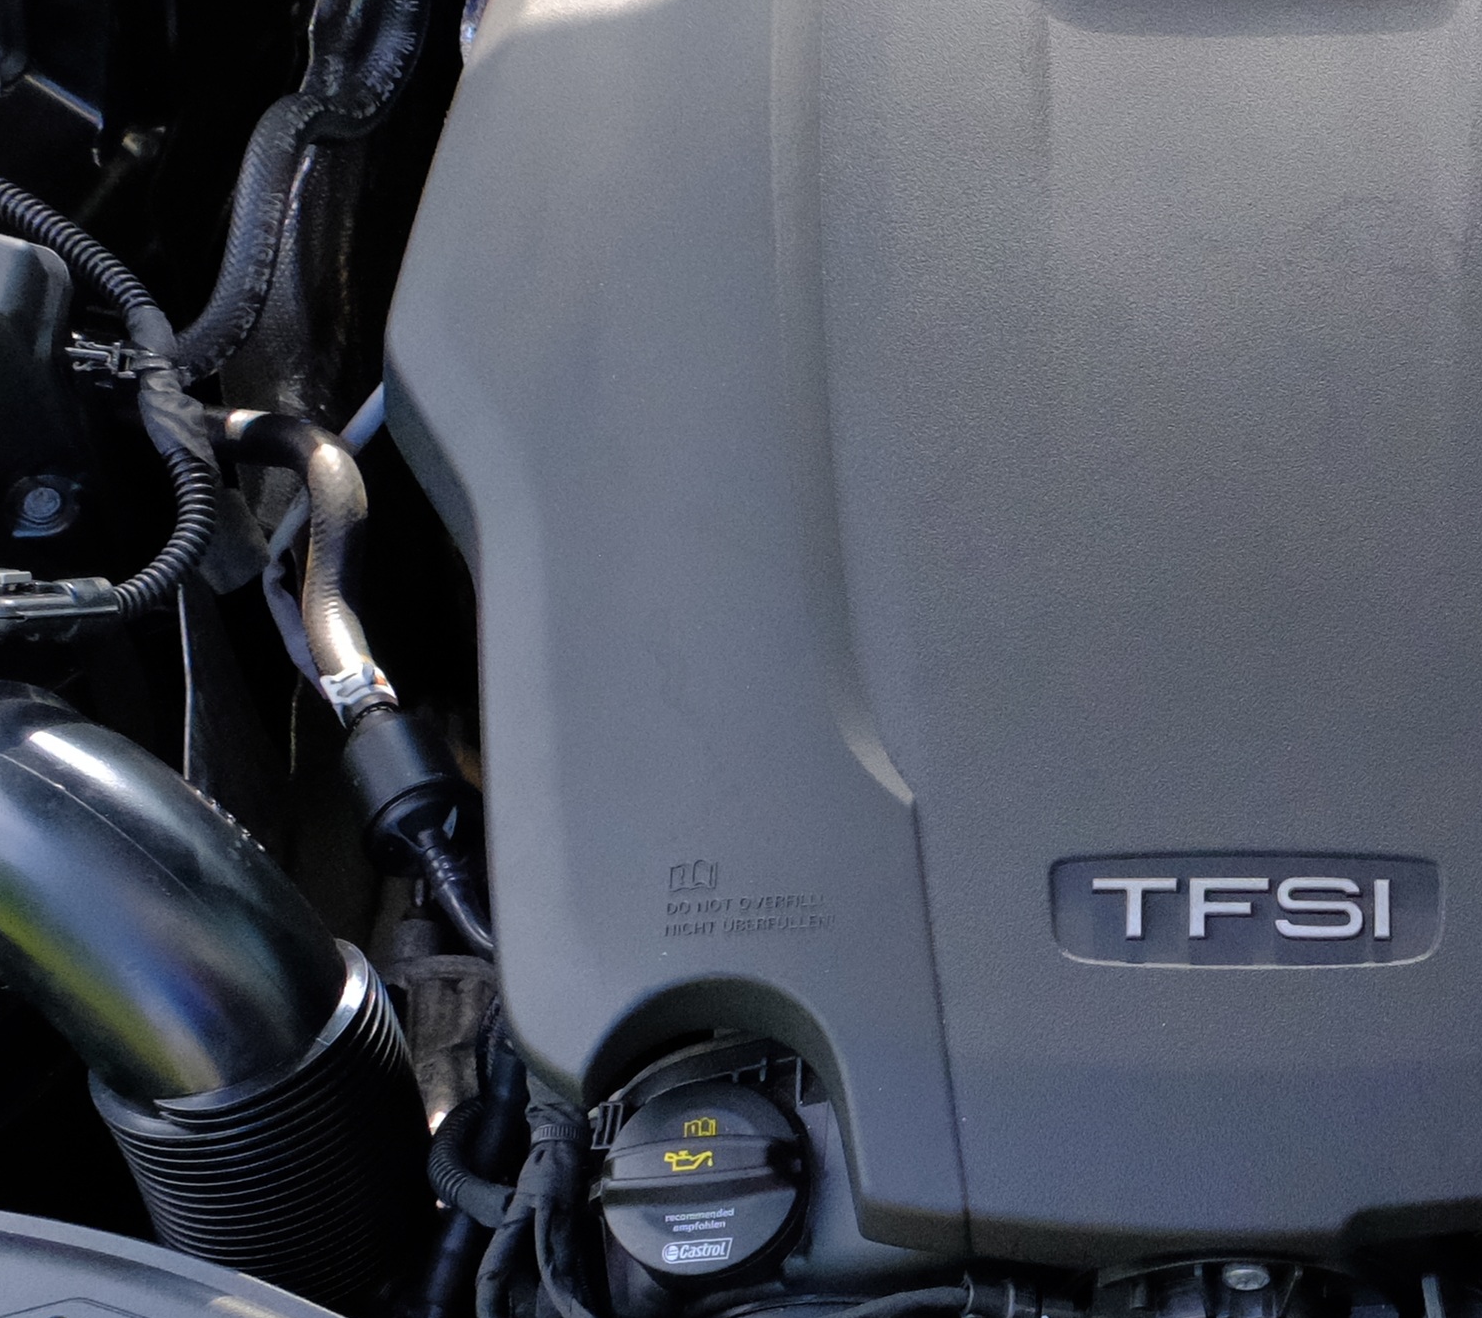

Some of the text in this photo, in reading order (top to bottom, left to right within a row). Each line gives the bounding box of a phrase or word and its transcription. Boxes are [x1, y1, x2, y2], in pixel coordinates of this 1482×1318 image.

[1090, 876, 1393, 943] TFSI
[664, 1207, 735, 1223] recommended
[672, 1219, 727, 1233] empfohlen
[679, 1241, 727, 1259] Castrol
